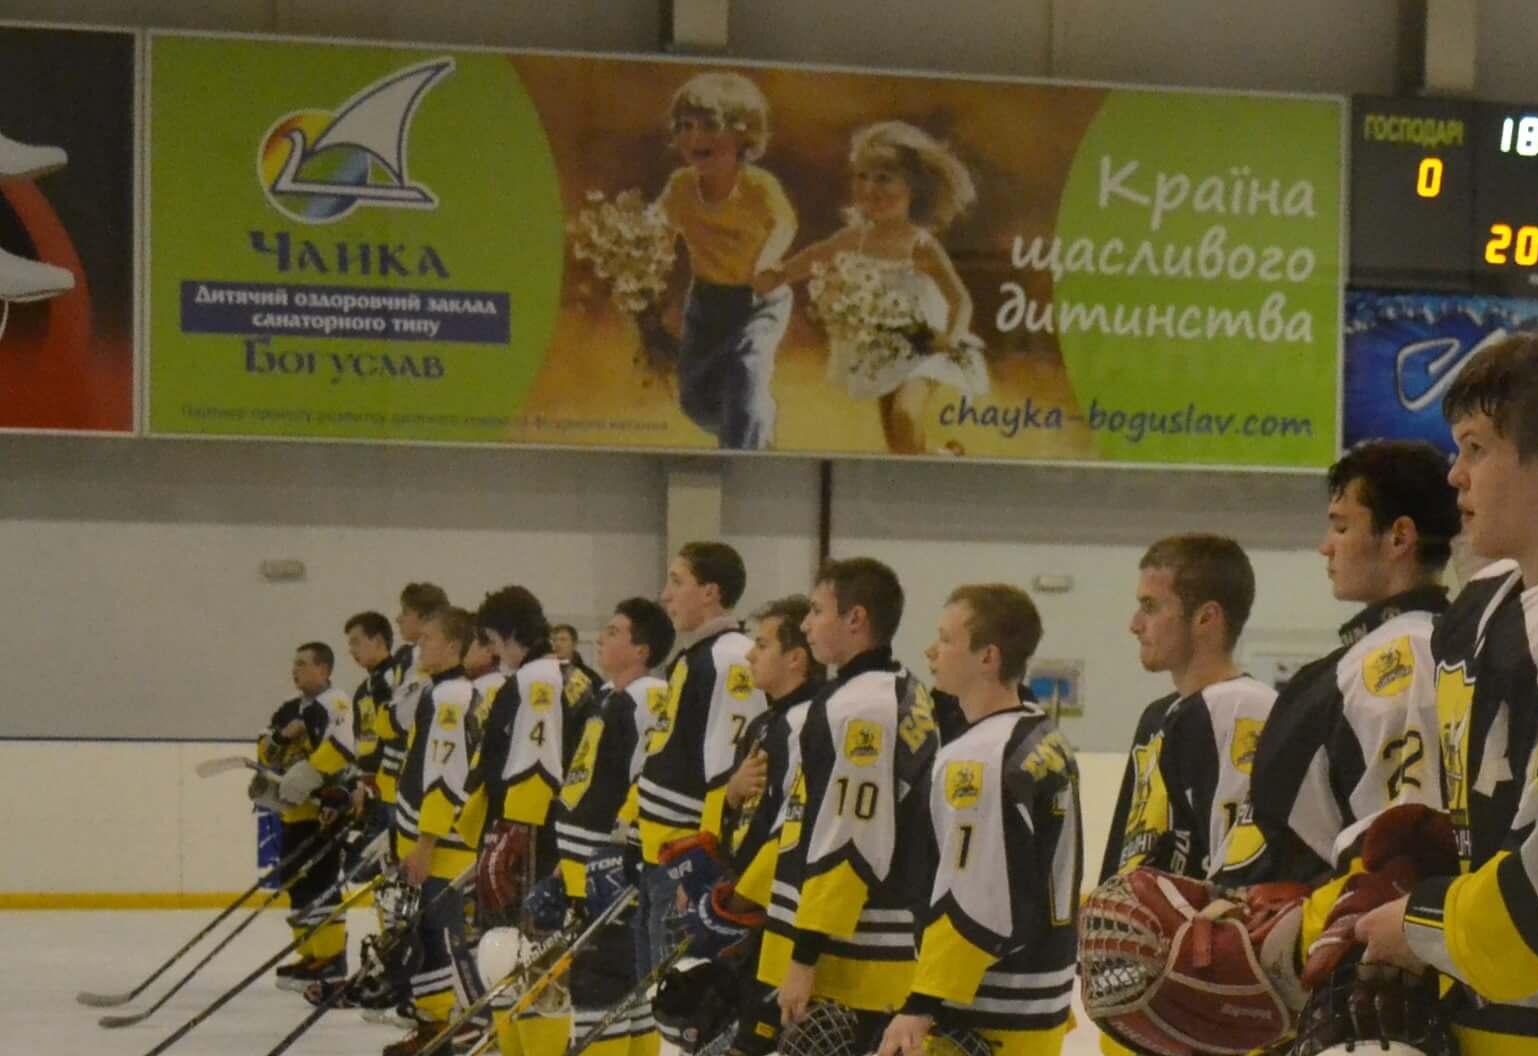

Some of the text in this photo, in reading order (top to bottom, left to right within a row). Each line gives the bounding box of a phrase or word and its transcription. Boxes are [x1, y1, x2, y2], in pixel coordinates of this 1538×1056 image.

[1100, 155, 1316, 231] Країна
[1416, 157, 1444, 198] 0
[1011, 227, 1315, 283] щасливого
[195, 285, 497, 315] Дитячий оздоровчий заклад
[996, 282, 1313, 343] дитинства
[252, 313, 441, 337] санаторного типу
[938, 397, 1313, 443] chayka-boguslav.com
[528, 720, 546, 748] 4
[1383, 729, 1424, 801] 2
[835, 777, 880, 821] 10
[959, 825, 973, 870] 1
